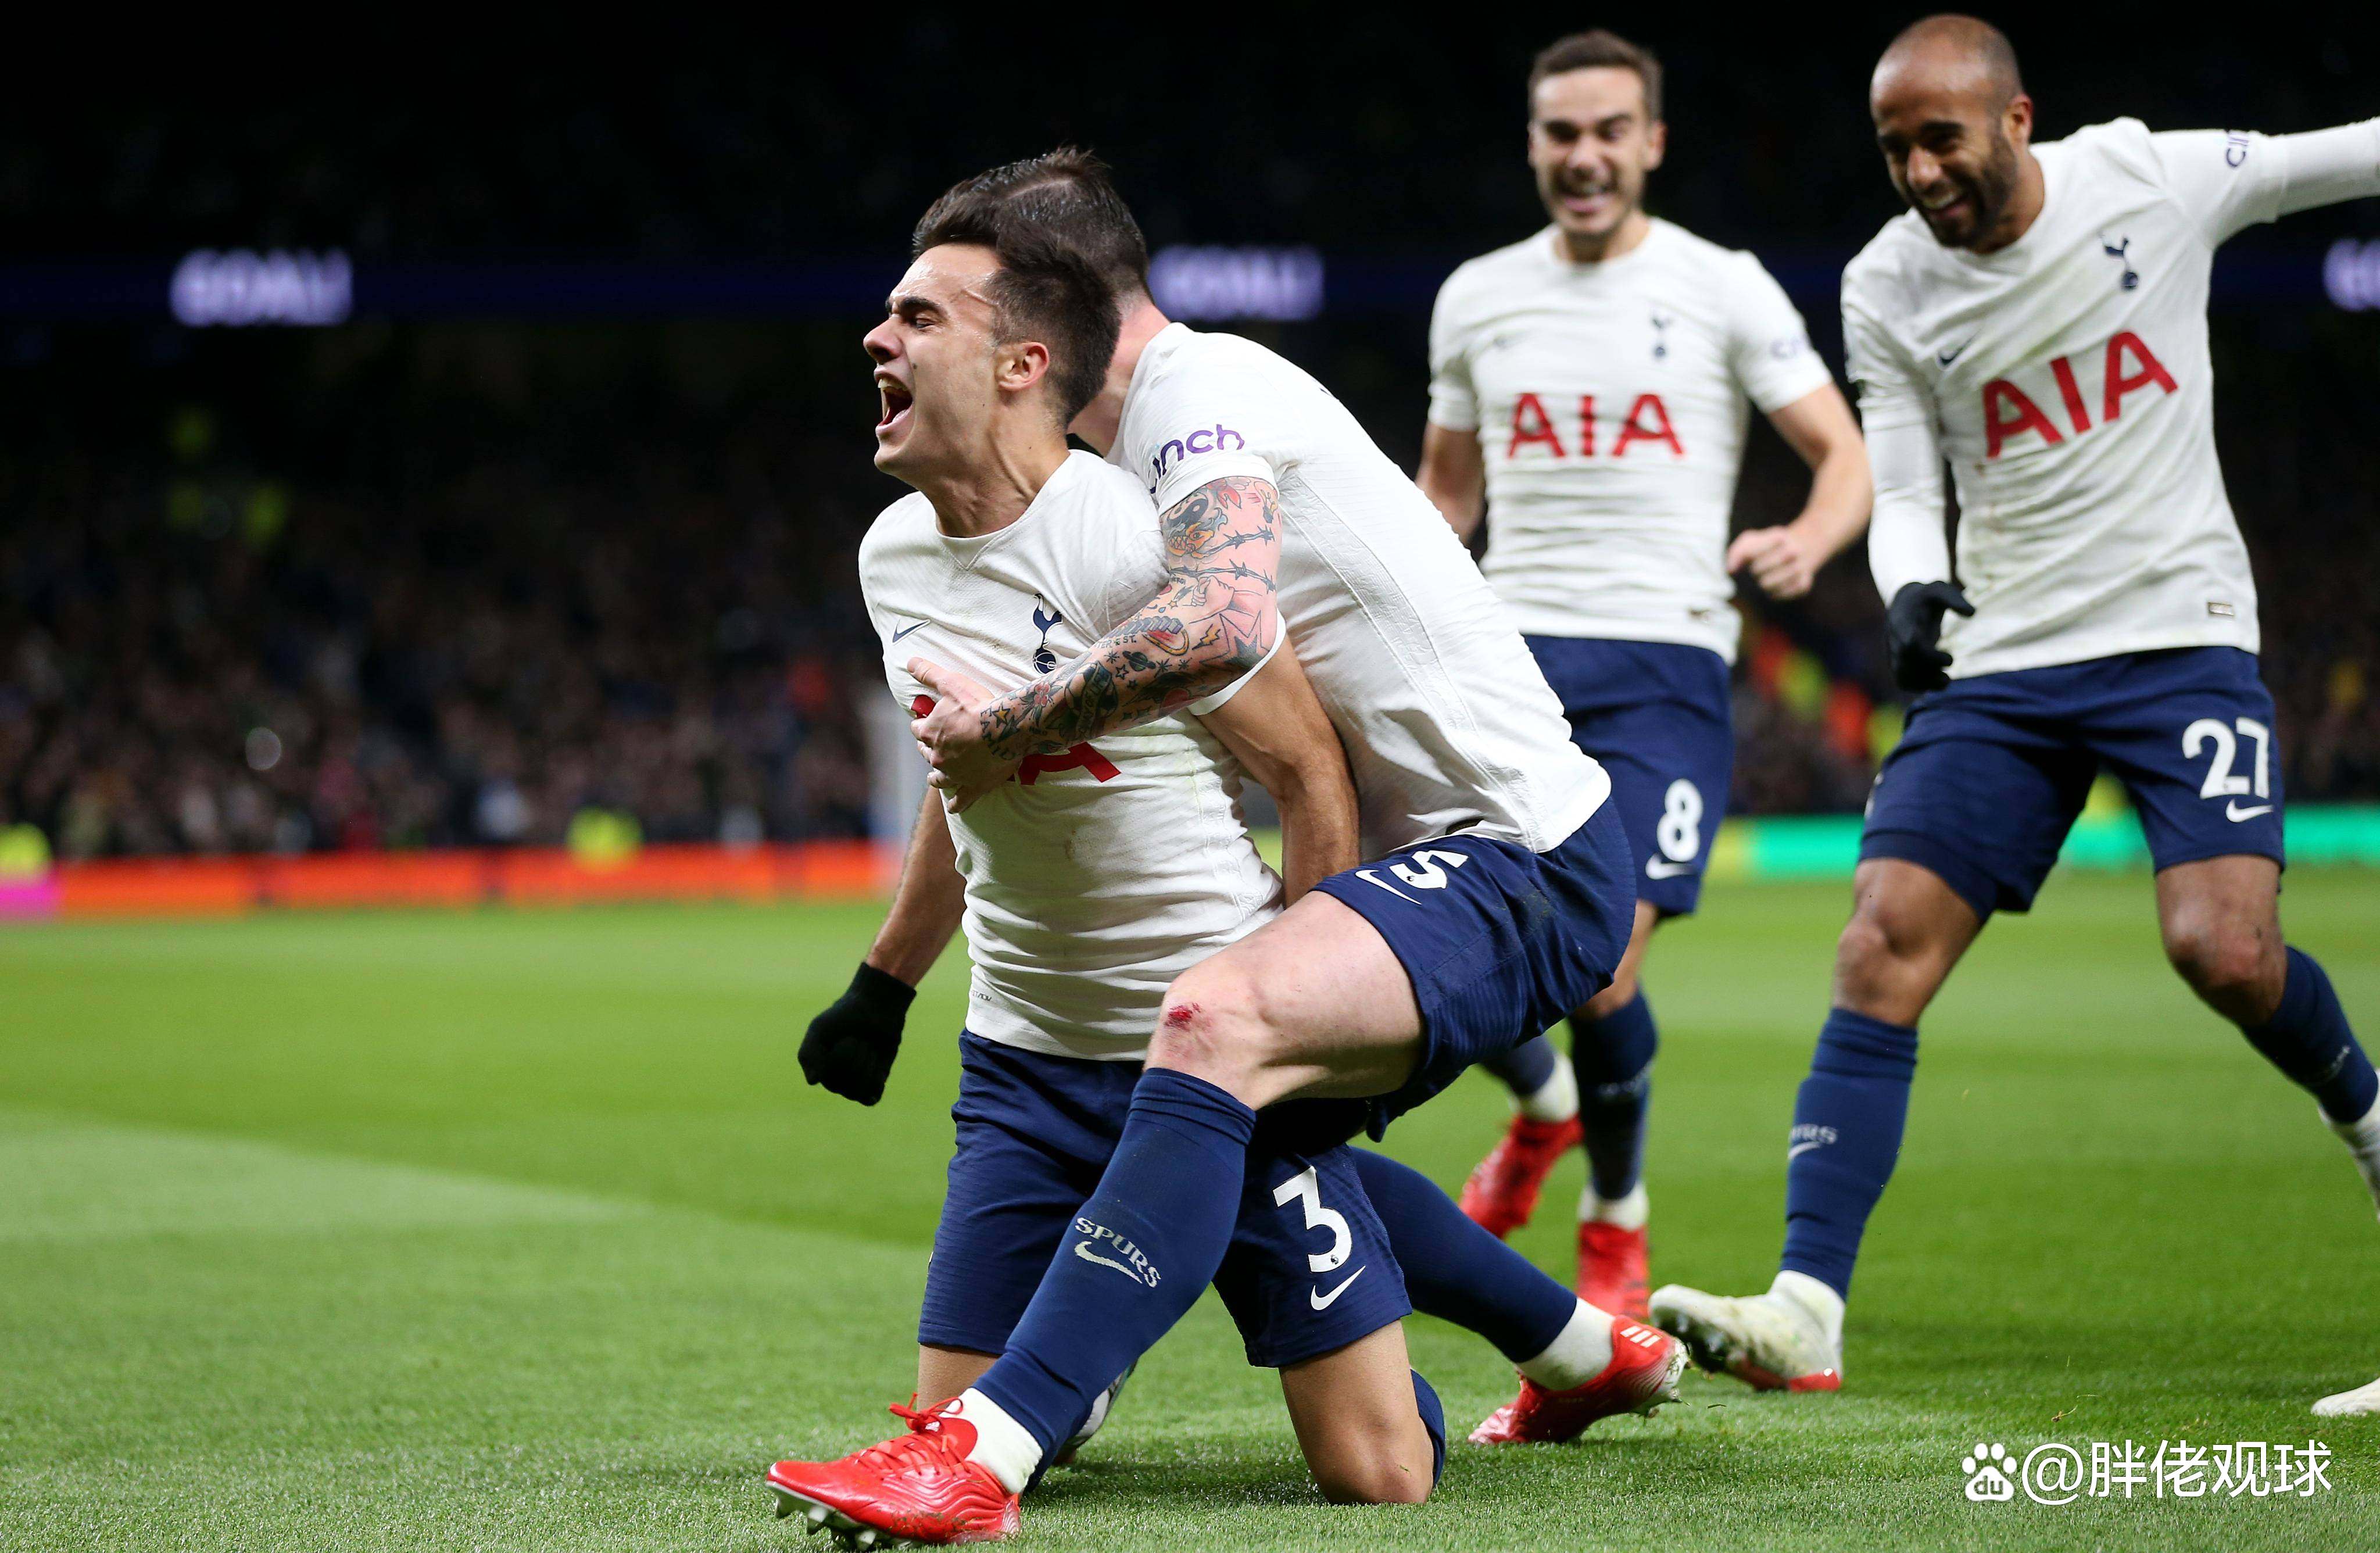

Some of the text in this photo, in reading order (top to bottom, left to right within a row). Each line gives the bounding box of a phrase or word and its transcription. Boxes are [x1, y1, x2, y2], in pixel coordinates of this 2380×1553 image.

[1507, 392, 1687, 458] AIA
[1981, 330, 2178, 460] AIA
[2182, 716, 2270, 800] 27
[1656, 778, 1703, 863] 8
[1389, 849, 1469, 889] 5
[1074, 1216, 1162, 1289] SPURS
[1272, 1165, 1353, 1273] 3
